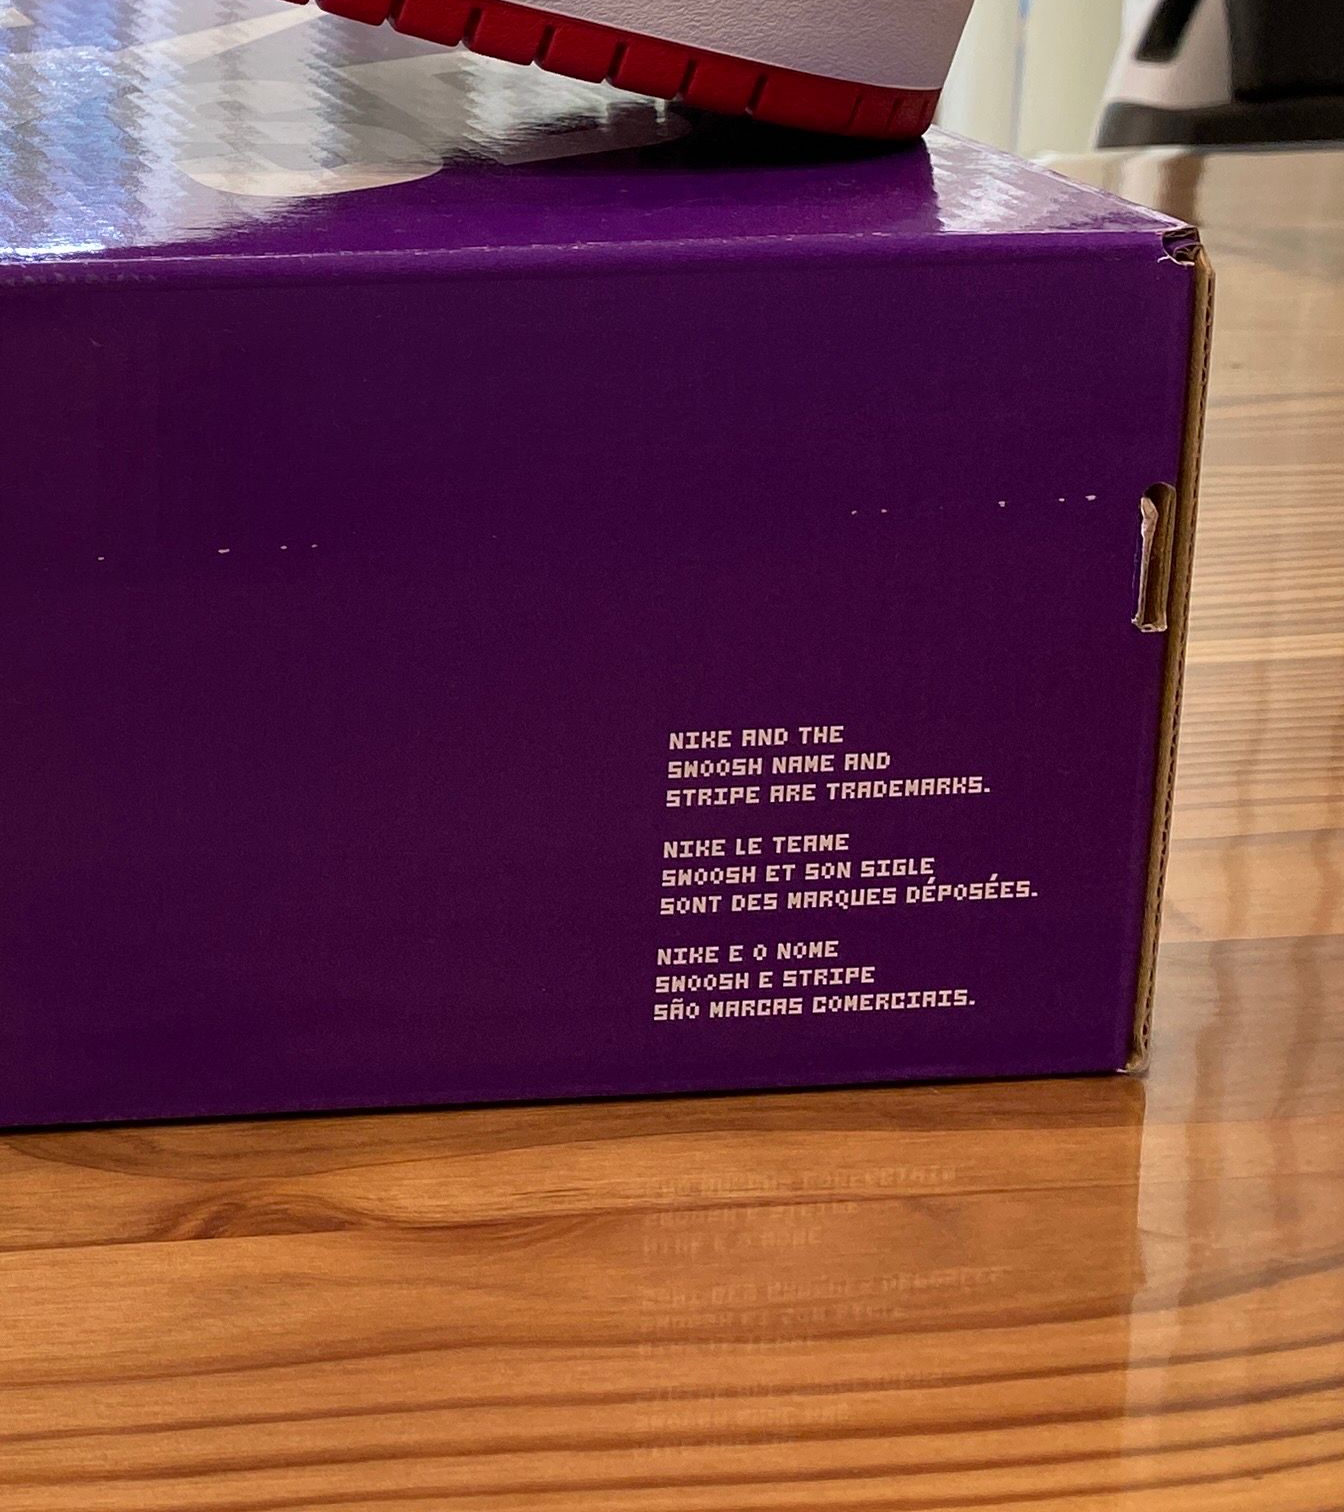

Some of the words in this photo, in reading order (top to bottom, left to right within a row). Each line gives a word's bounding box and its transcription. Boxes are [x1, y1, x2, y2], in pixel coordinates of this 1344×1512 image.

[670, 731, 731, 749] NIKE
[742, 728, 788, 746] AND
[799, 726, 843, 744] THE
[668, 758, 762, 778] SWOOSH
[772, 755, 834, 774] NAME
[845, 752, 890, 770] AND
[666, 787, 760, 807] STRIPE
[770, 784, 816, 802] ARE
[827, 777, 990, 799] TRADEMARKS.
[664, 840, 725, 858] NIKE
[736, 838, 762, 855] LE
[662, 866, 756, 886] SWOOSH
[766, 864, 795, 881] ET
[805, 862, 851, 880] SON
[861, 858, 934, 877] SIGLE
[660, 896, 721, 914] SONT
[732, 893, 777, 911] DES
[788, 888, 896, 909] MARQUES
[906, 874, 1037, 903] DÉPOSÉES.
[658, 947, 719, 965] NIKE
[729, 945, 743, 961] E
[753, 944, 767, 960] O
[777, 941, 838, 959] NOME
[656, 973, 749, 992] SWOOSH
[759, 972, 773, 988] E
[783, 967, 875, 986] STRIPE
[654, 998, 699, 1020] SÃO
[710, 998, 802, 1017] MARCAS
[813, 990, 975, 1013] COMERCIAIS.
